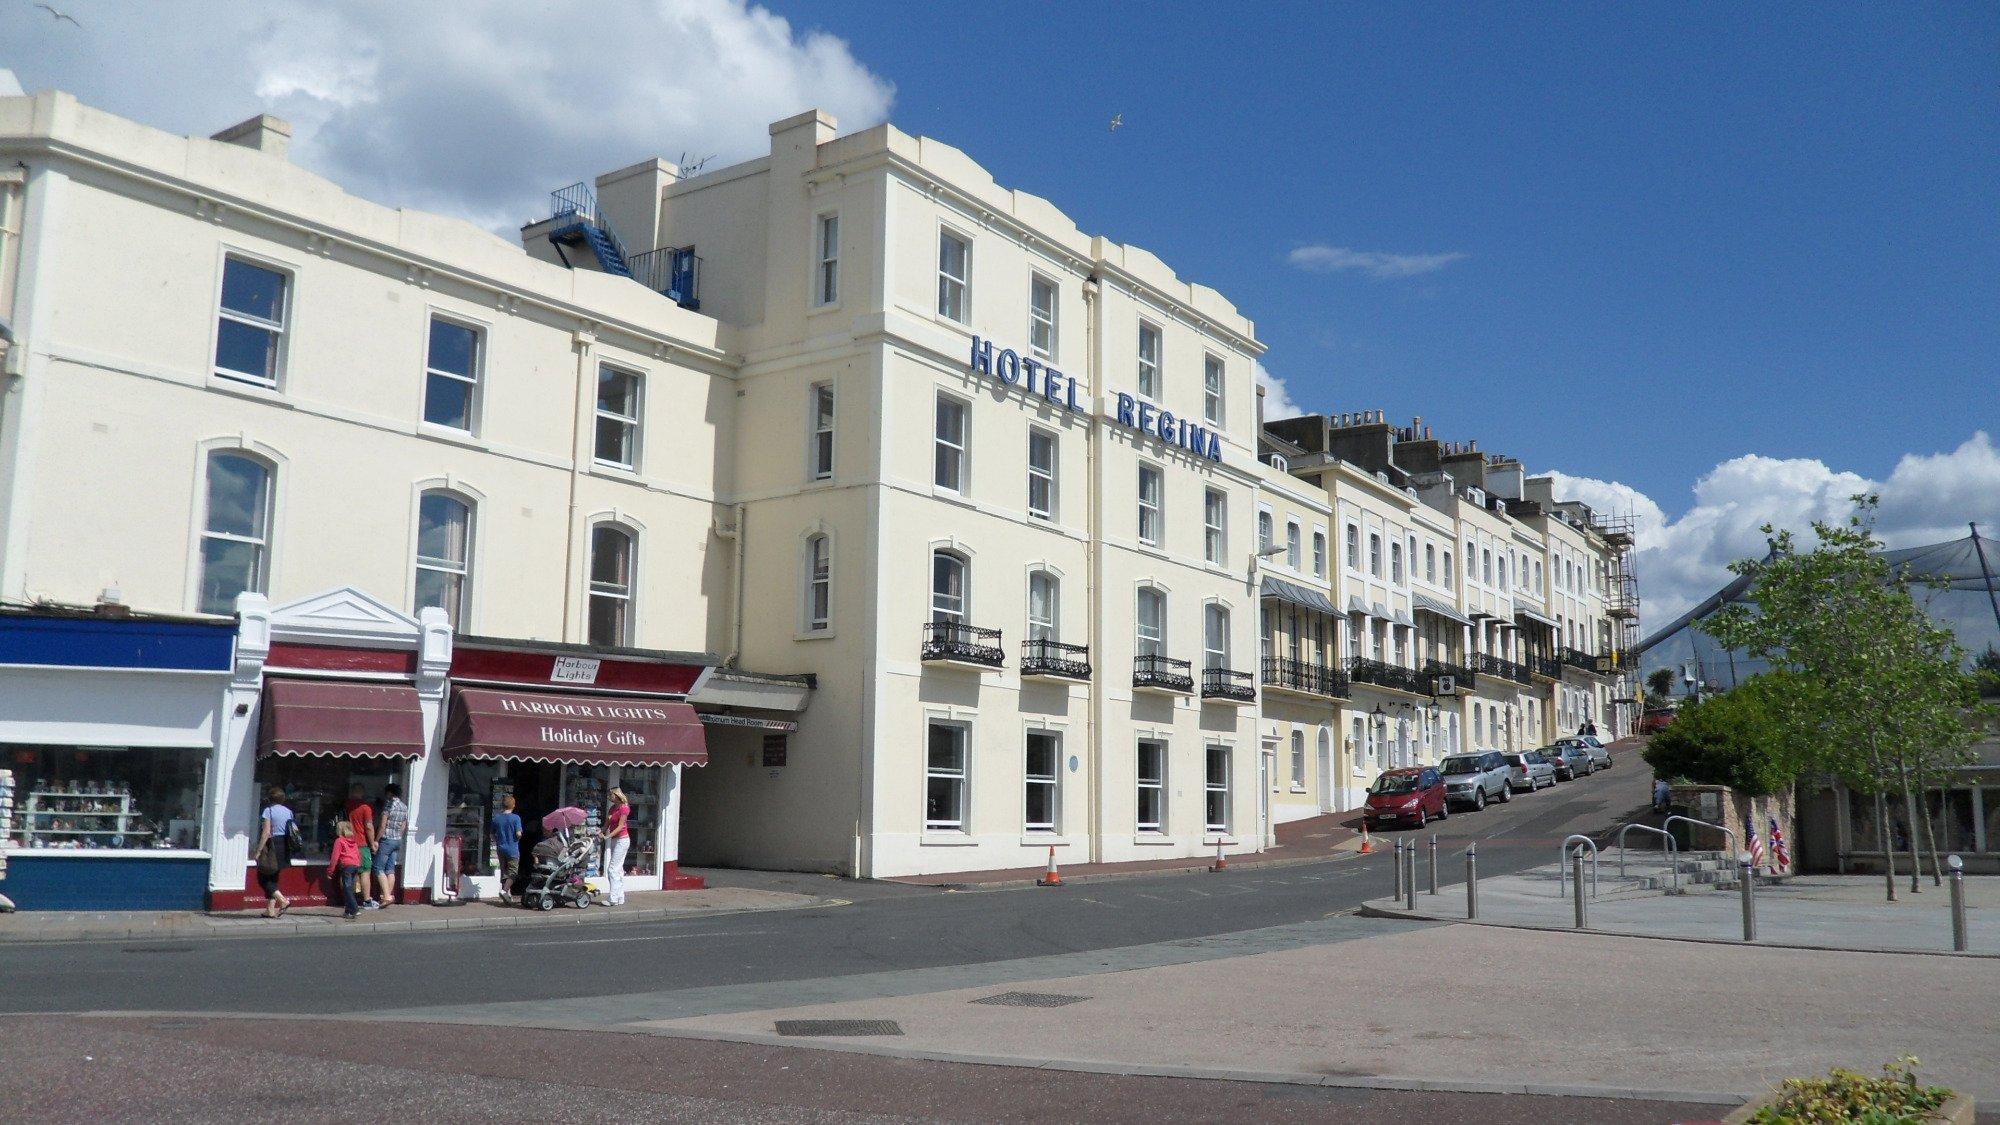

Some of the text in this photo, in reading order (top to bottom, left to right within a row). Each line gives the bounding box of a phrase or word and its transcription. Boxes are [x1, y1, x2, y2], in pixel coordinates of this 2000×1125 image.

[971, 335, 1223, 463] HOTEL REGINA
[556, 657, 598, 670] Harbour
[556, 668, 592, 681] Lights
[501, 699, 667, 720] HARBOUR LIGHTS
[540, 726, 646, 748] Holiday Gifts
